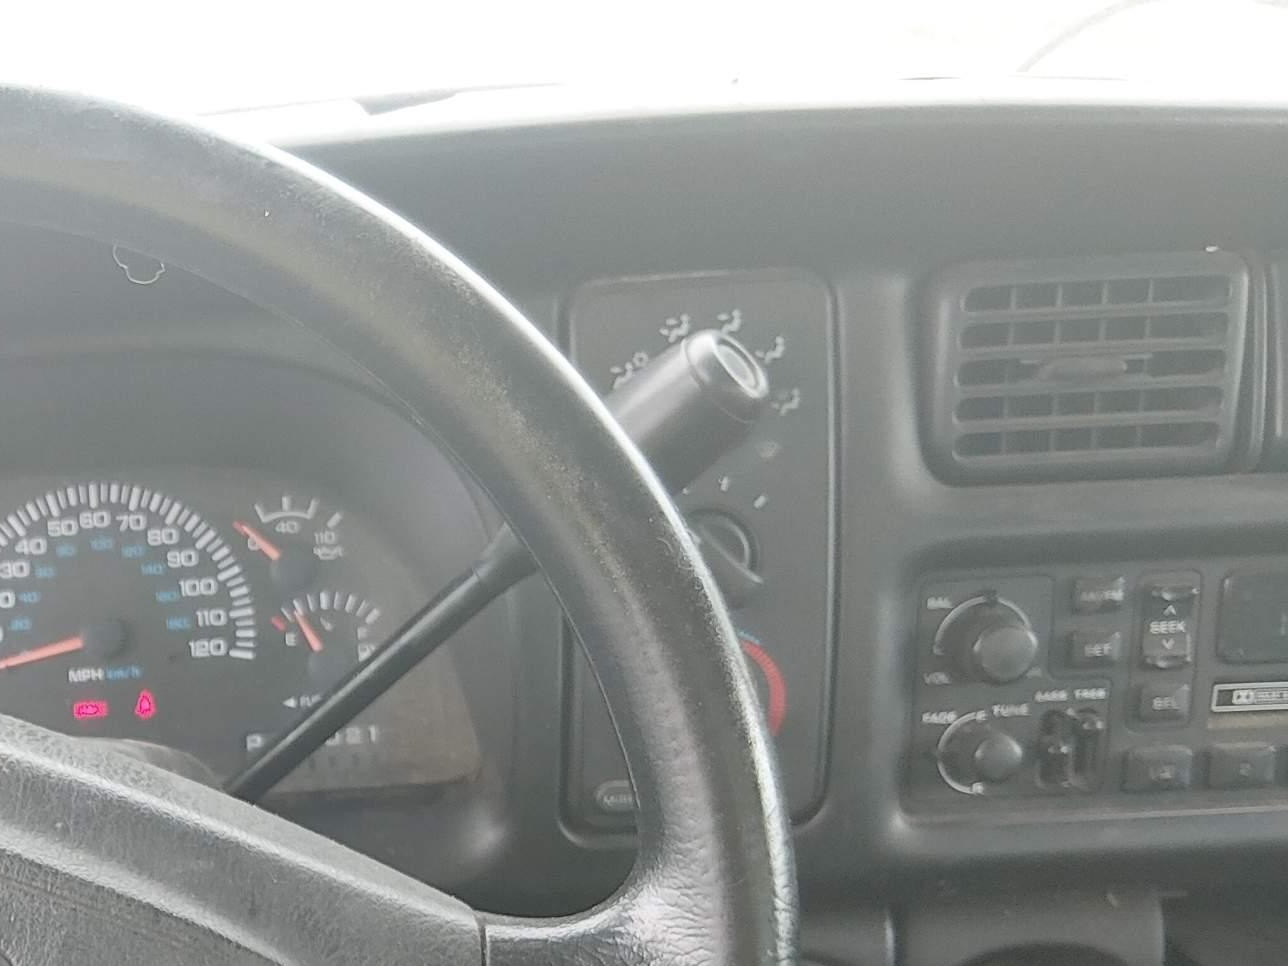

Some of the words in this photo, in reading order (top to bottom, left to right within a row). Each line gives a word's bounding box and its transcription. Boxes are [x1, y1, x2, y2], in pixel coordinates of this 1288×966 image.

[47, 519, 78, 537] 50
[79, 511, 111, 529] 60
[116, 514, 147, 532] 70
[275, 520, 300, 534] 40
[15, 537, 47, 555] 40
[147, 528, 179, 546] 80
[313, 530, 337, 545] 110
[167, 550, 199, 568] 90
[179, 577, 218, 597] 100
[196, 609, 227, 627] 110
[1150, 620, 1186, 635] SEEK
[189, 639, 227, 657] 120
[285, 632, 296, 647] E
[68, 667, 104, 682] MPH
[992, 703, 1030, 717] TUNE
[368, 724, 379, 743] 1
